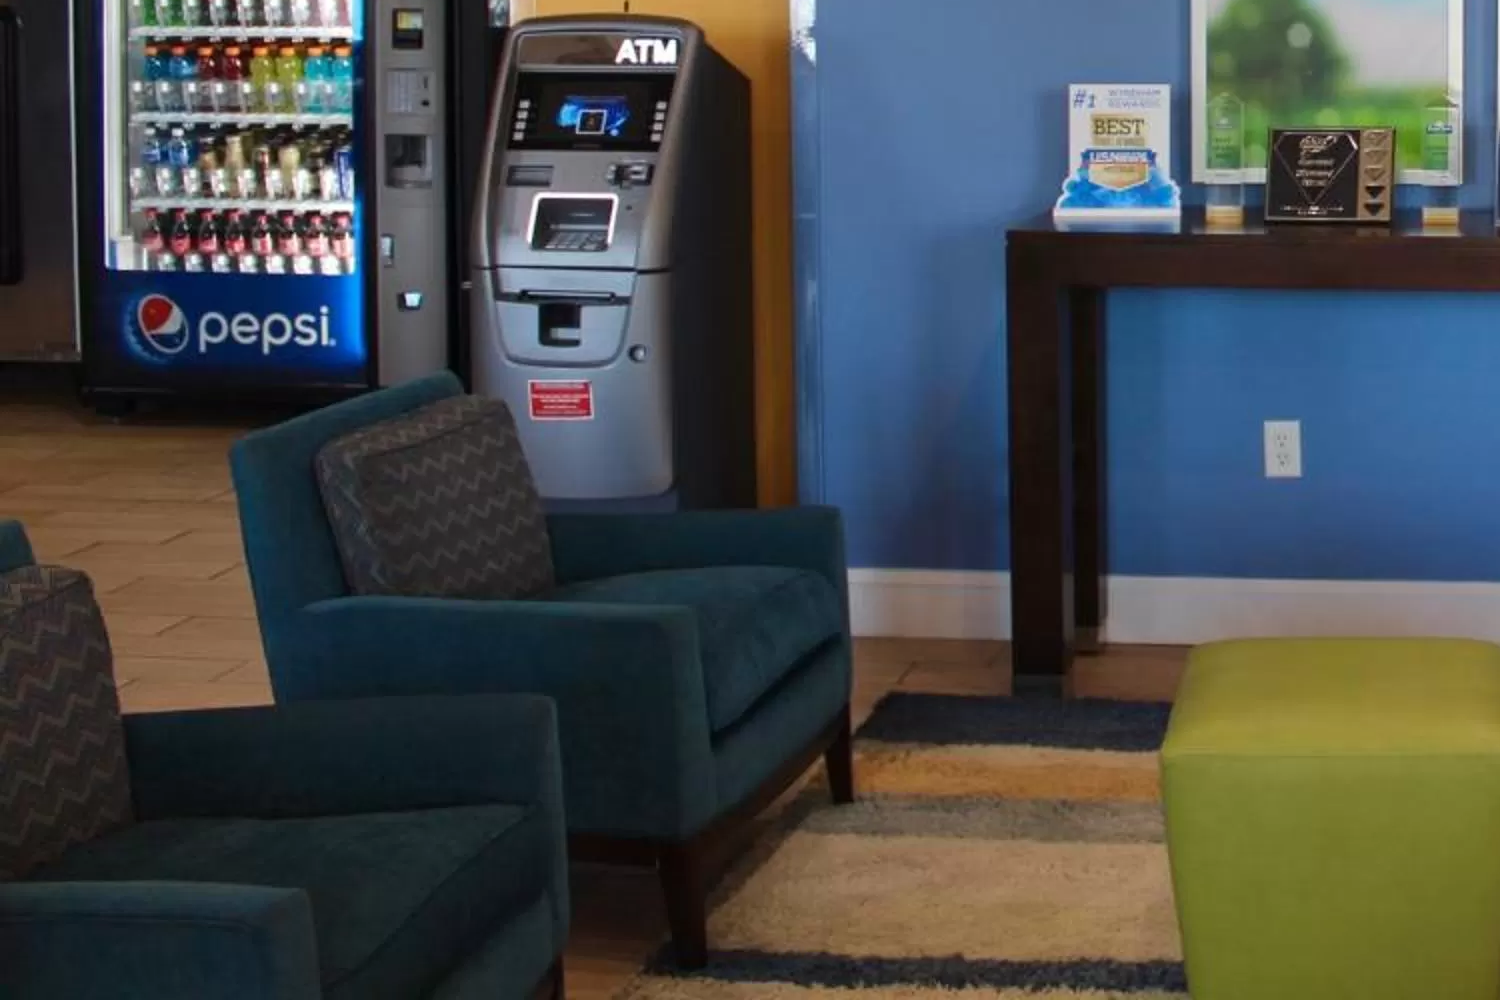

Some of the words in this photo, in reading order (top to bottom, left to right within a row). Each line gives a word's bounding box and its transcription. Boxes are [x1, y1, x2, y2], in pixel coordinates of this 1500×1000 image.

[615, 38, 677, 64] ATM
[1093, 117, 1145, 135] BEST
[198, 305, 329, 355] pepsi
